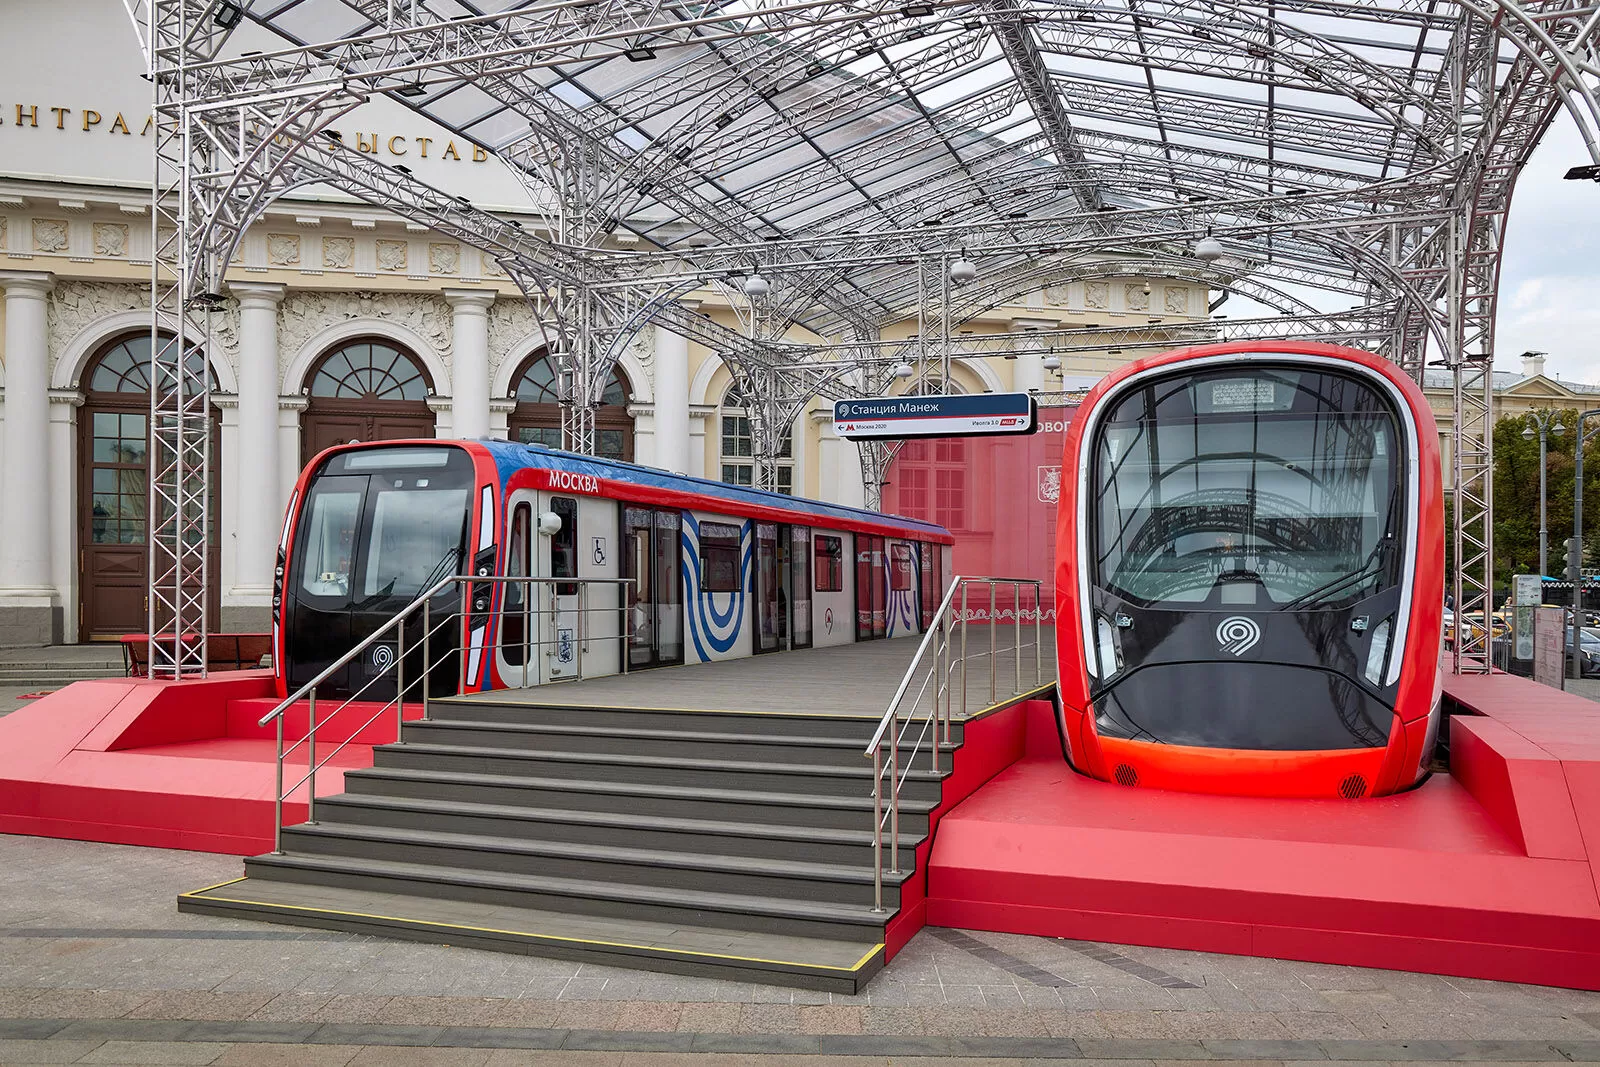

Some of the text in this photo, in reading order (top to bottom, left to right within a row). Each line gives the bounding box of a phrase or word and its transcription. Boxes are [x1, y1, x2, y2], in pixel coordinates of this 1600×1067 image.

[851, 403, 939, 415] Станция Манеж
[549, 470, 599, 493] МОСКВА
